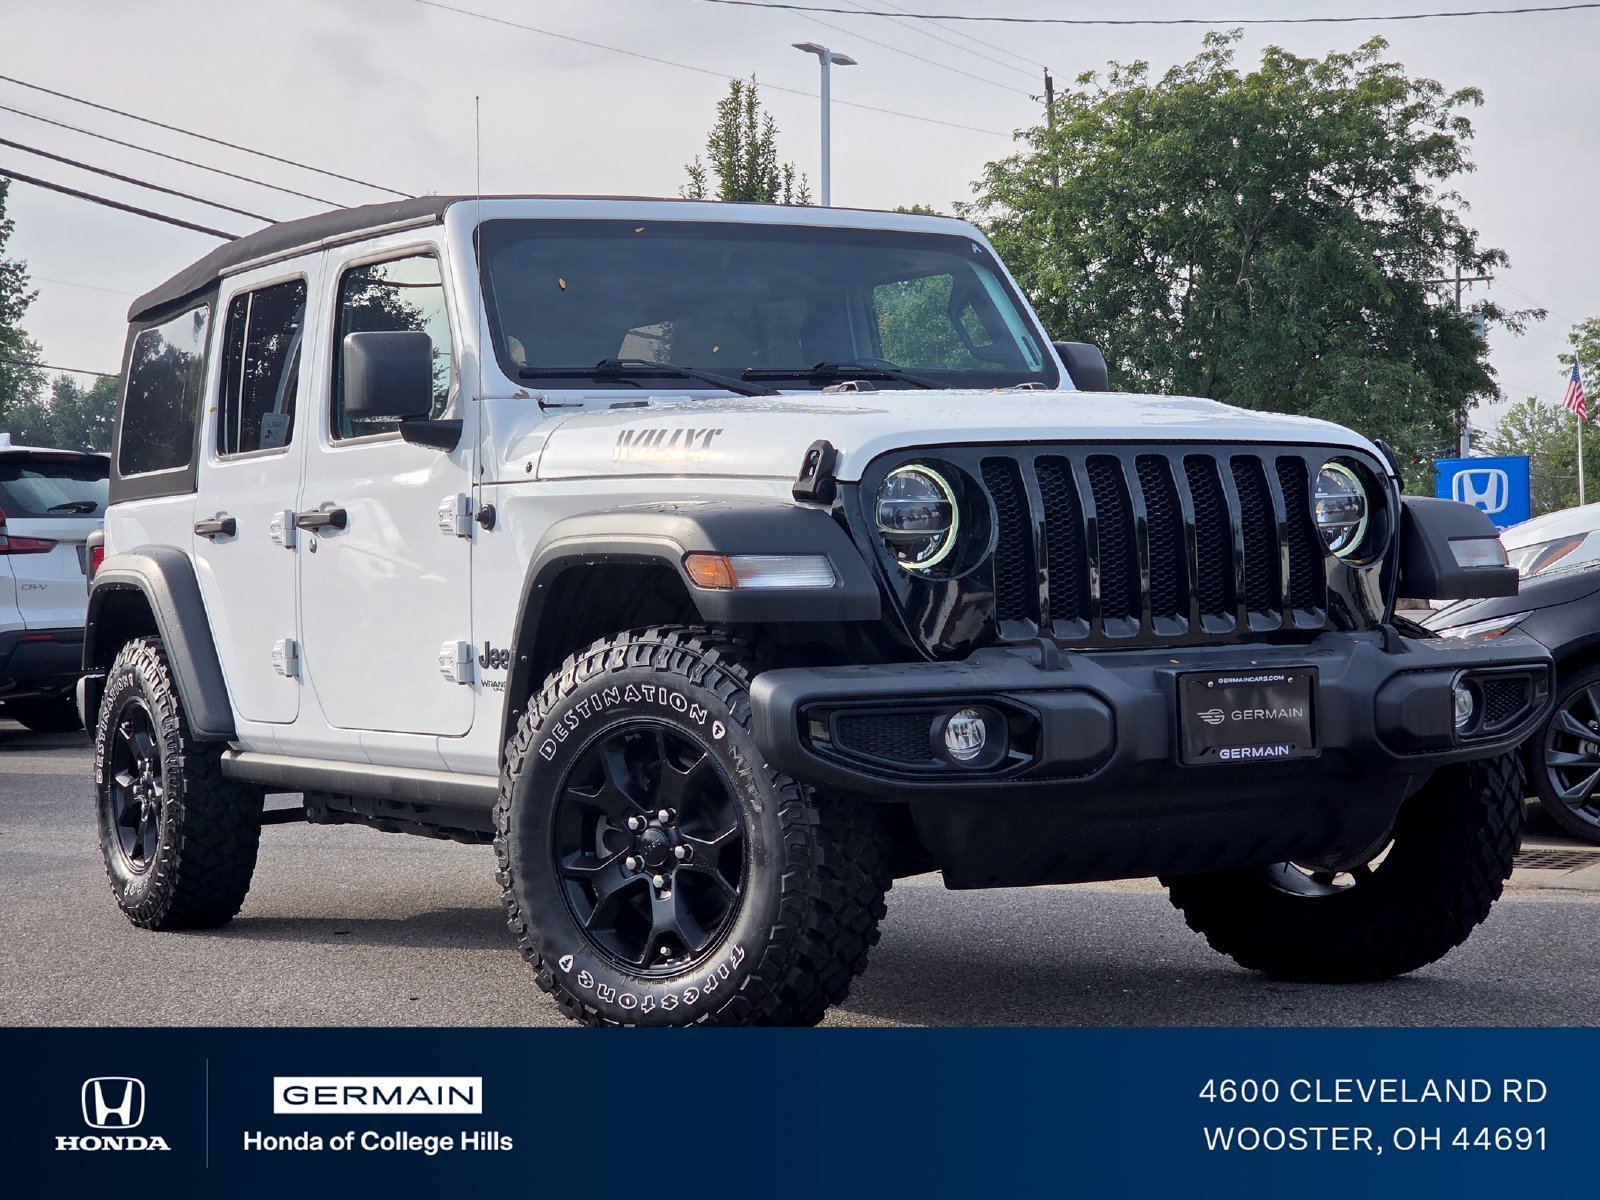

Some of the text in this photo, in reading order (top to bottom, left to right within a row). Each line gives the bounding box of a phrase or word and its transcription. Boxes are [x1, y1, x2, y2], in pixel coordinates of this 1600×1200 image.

[20, 583, 48, 591] CR-V
[478, 640, 510, 670] Jee
[480, 679, 506, 688] WRAN
[1217, 674, 1285, 684] GERMAINCARS.COM
[1231, 707, 1303, 720] GERMAIN
[95, 673, 129, 784] DESTINATION
[539, 684, 708, 761] DESTINATION
[1219, 745, 1289, 759] GERMAIN
[577, 944, 745, 1013] Firestone
